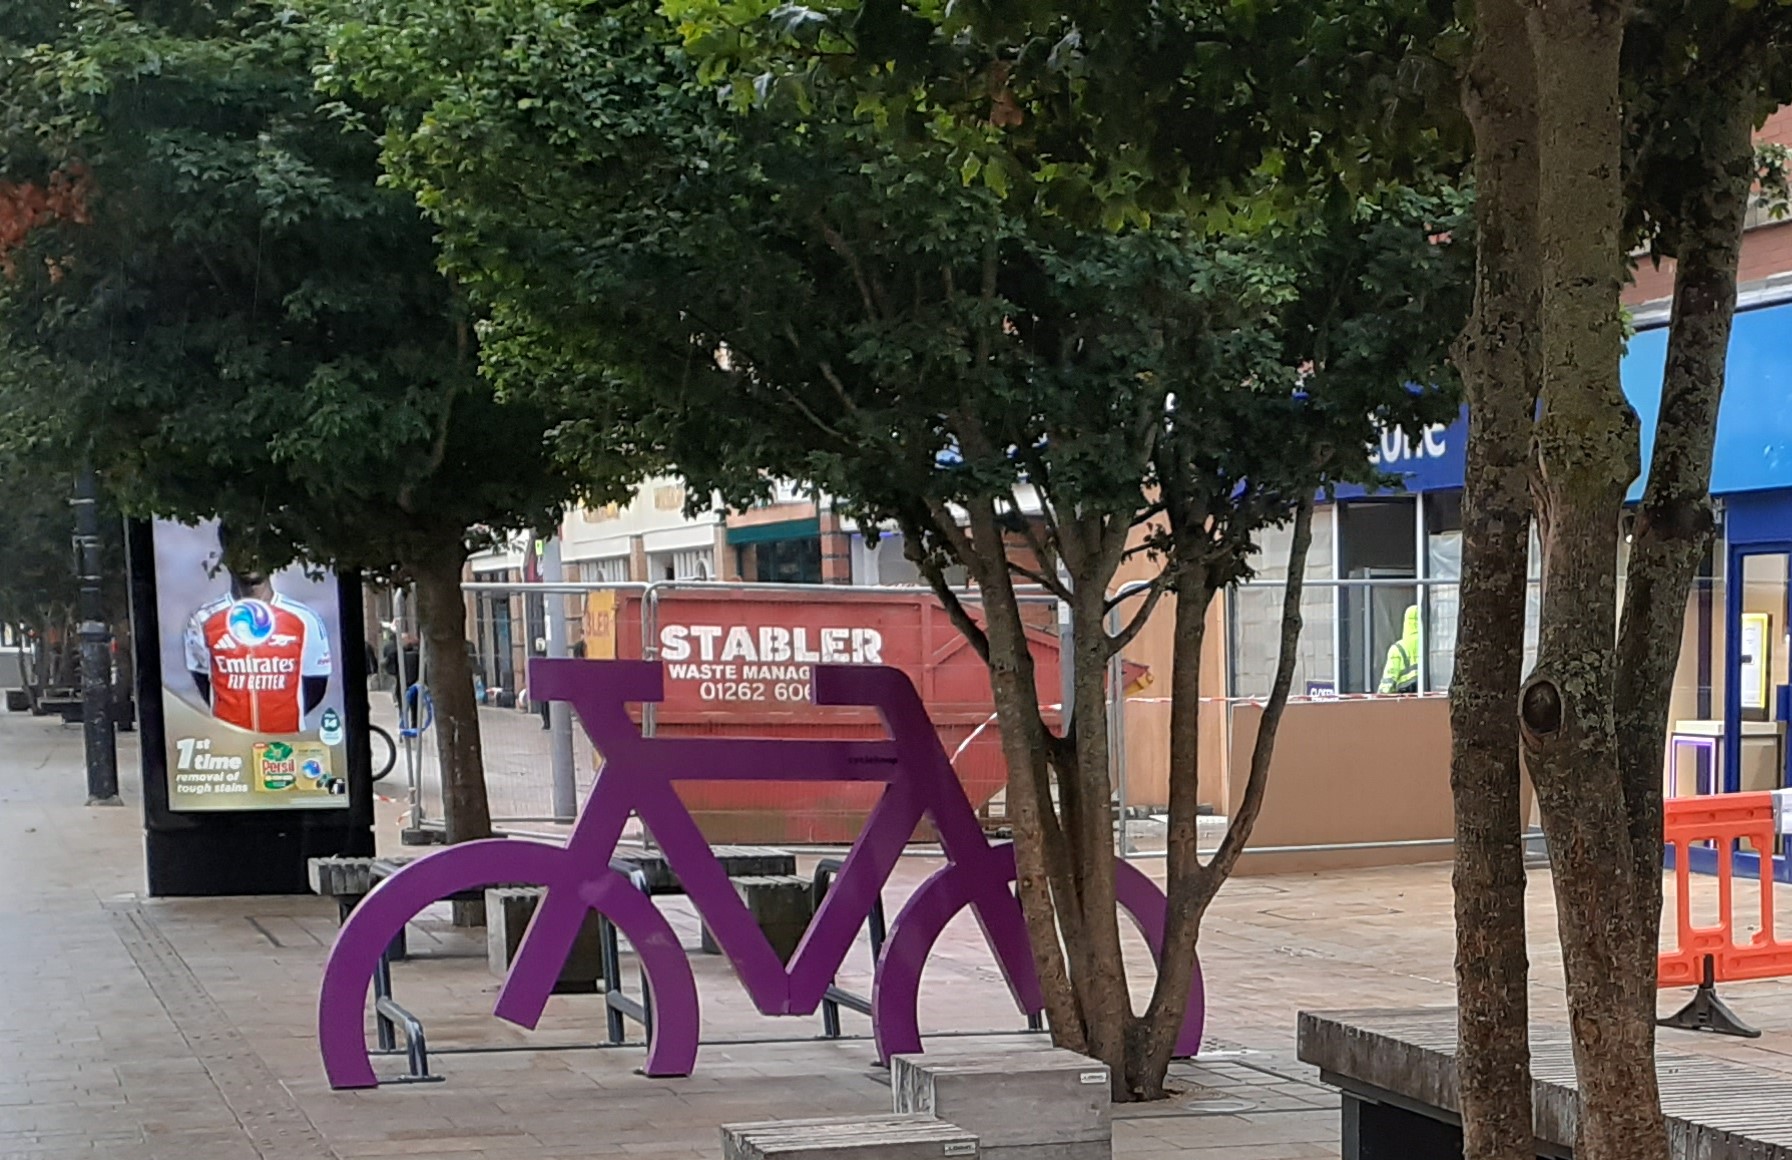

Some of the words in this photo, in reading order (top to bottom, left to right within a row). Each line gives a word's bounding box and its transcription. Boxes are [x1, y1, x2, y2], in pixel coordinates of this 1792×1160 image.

[660, 624, 883, 664] STABLER
[213, 655, 296, 673] Emirates
[668, 665, 737, 680] WASTE
[228, 675, 247, 689] FLY
[247, 674, 286, 690] BETTER
[699, 682, 765, 701] 01262
[194, 753, 242, 770] time
[262, 759, 295, 775] Persil
[176, 772, 224, 782] removal
[226, 771, 240, 782] of
[176, 783, 212, 794] tough
[214, 783, 248, 793] stains
